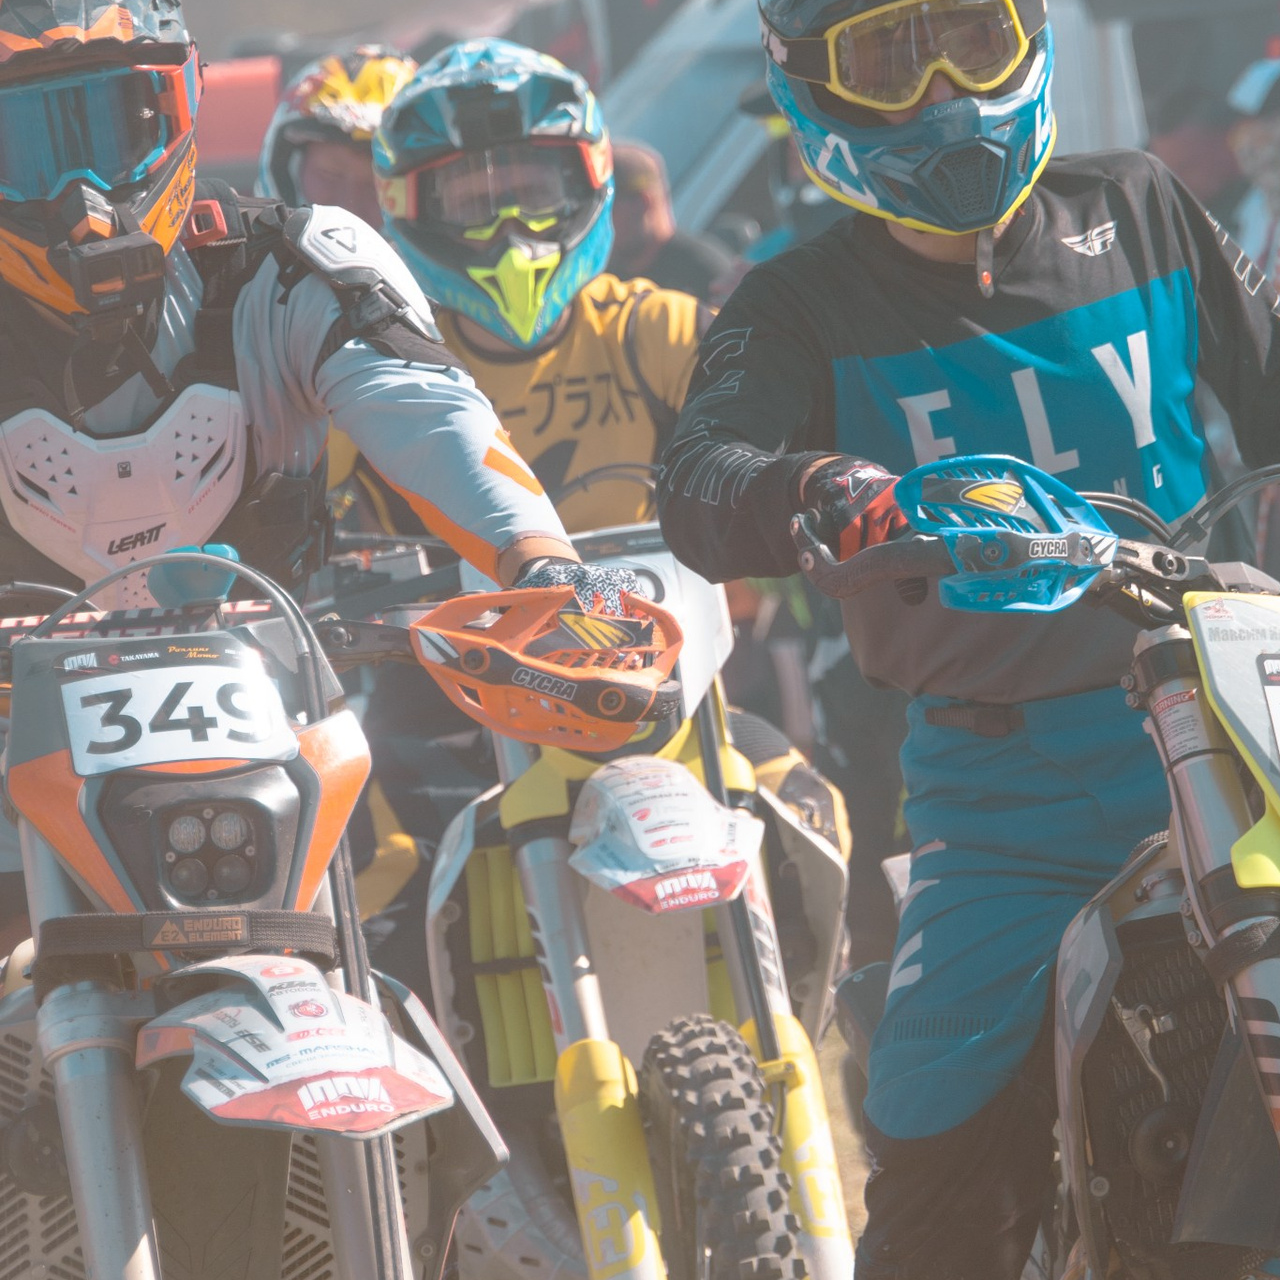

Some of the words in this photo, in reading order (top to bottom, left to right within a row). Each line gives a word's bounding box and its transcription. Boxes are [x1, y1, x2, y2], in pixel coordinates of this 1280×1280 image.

[897, 329, 1156, 475] FLY
[107, 523, 167, 556] LEATT
[1029, 539, 1068, 557] CYCRA
[120, 652, 160, 662] TAKAYAMA
[511, 667, 578, 701] CYCRA
[80, 681, 265, 755] 349
[661, 890, 719, 909] ENDURO
[184, 917, 242, 932] ENDURO
[161, 929, 180, 942] E2
[188, 930, 242, 942] ELEMENT
[308, 1103, 395, 1121] ENDURO
